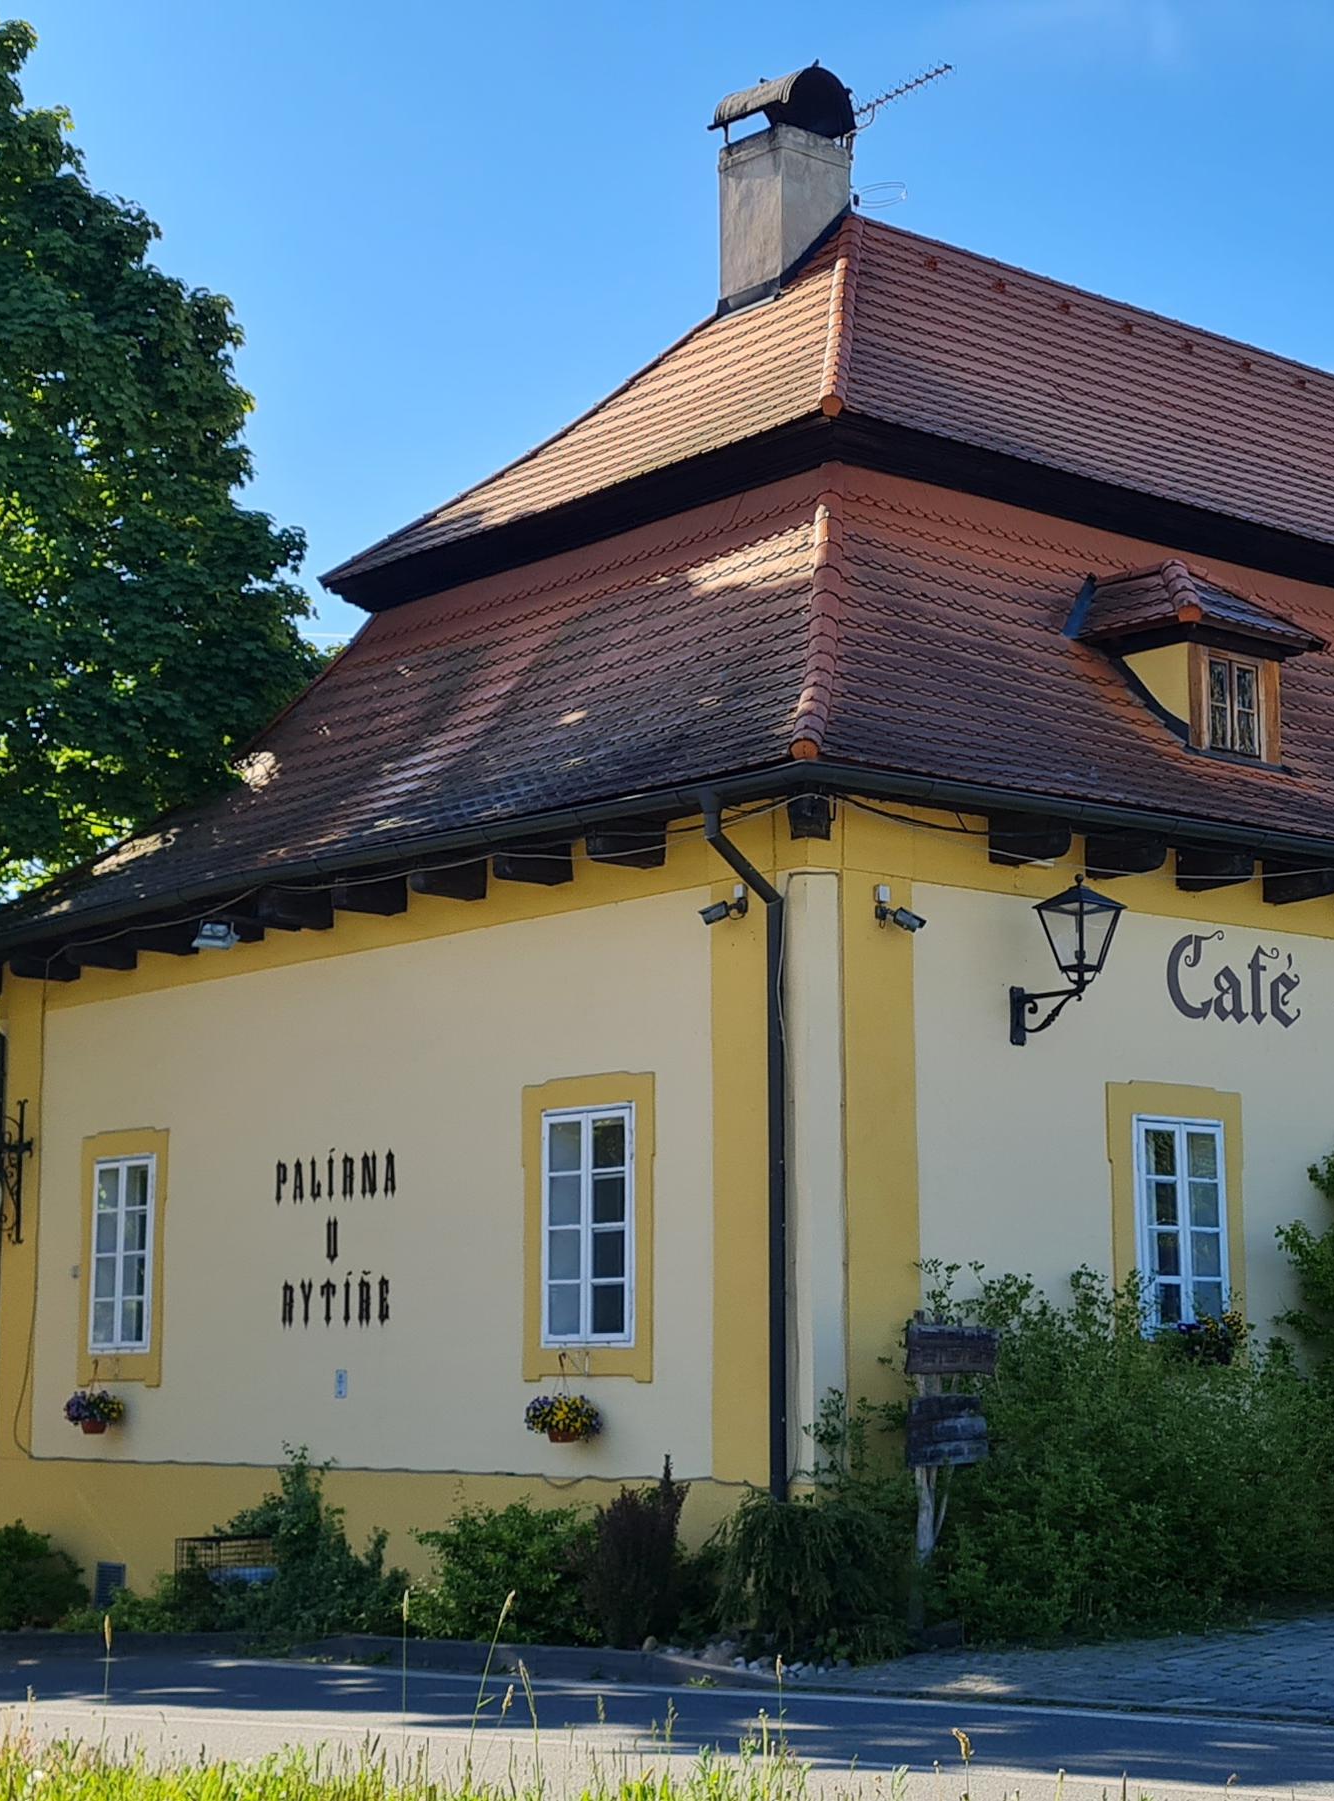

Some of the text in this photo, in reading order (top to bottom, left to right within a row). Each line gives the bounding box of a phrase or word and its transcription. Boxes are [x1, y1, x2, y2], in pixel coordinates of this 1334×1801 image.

[1167, 930, 1302, 1029] Café
[275, 1147, 396, 1206] PALÍRNA
[326, 1214, 339, 1266] U
[281, 1269, 391, 1331] RYTÍŘE
